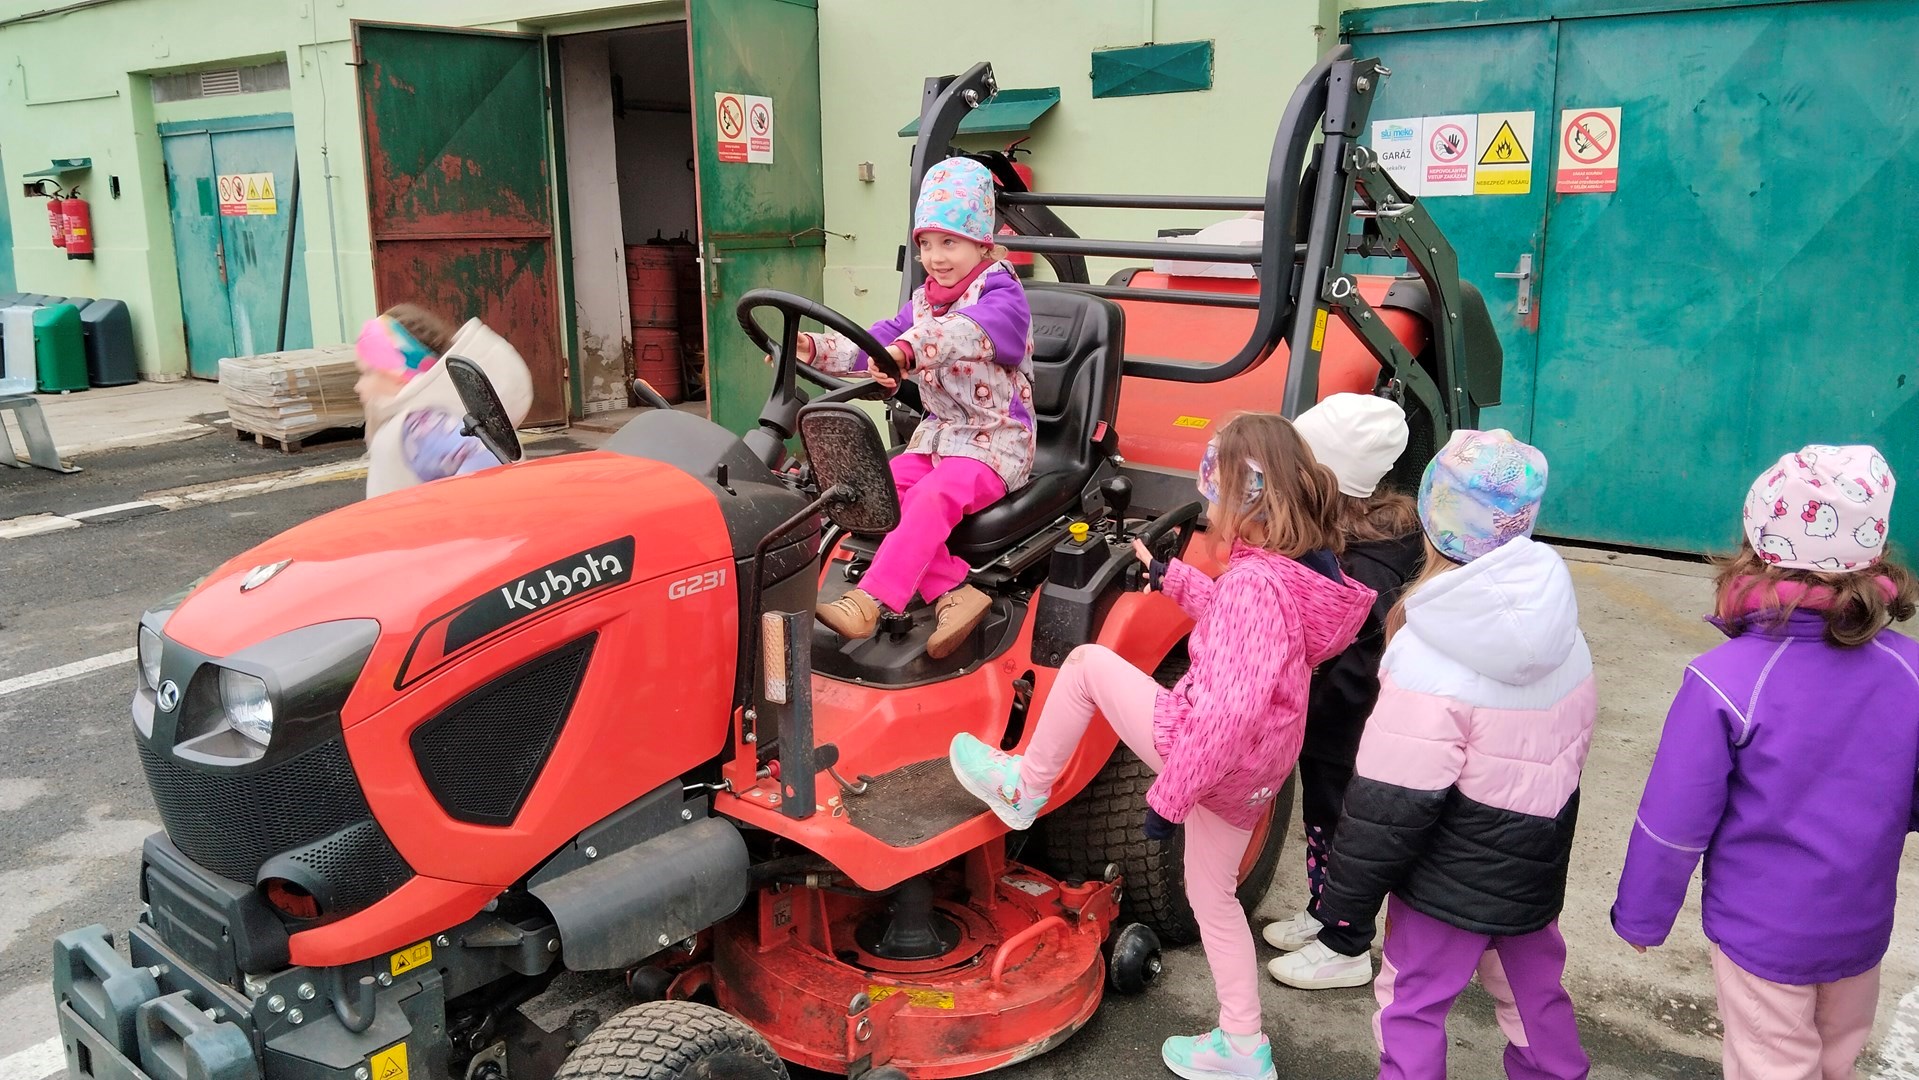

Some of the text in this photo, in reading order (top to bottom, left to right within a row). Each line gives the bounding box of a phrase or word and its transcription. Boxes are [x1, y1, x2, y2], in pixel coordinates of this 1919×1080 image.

[1382, 149, 1411, 160] GARÁŽ
[501, 554, 623, 610] Kubota
[668, 569, 727, 600] G231
